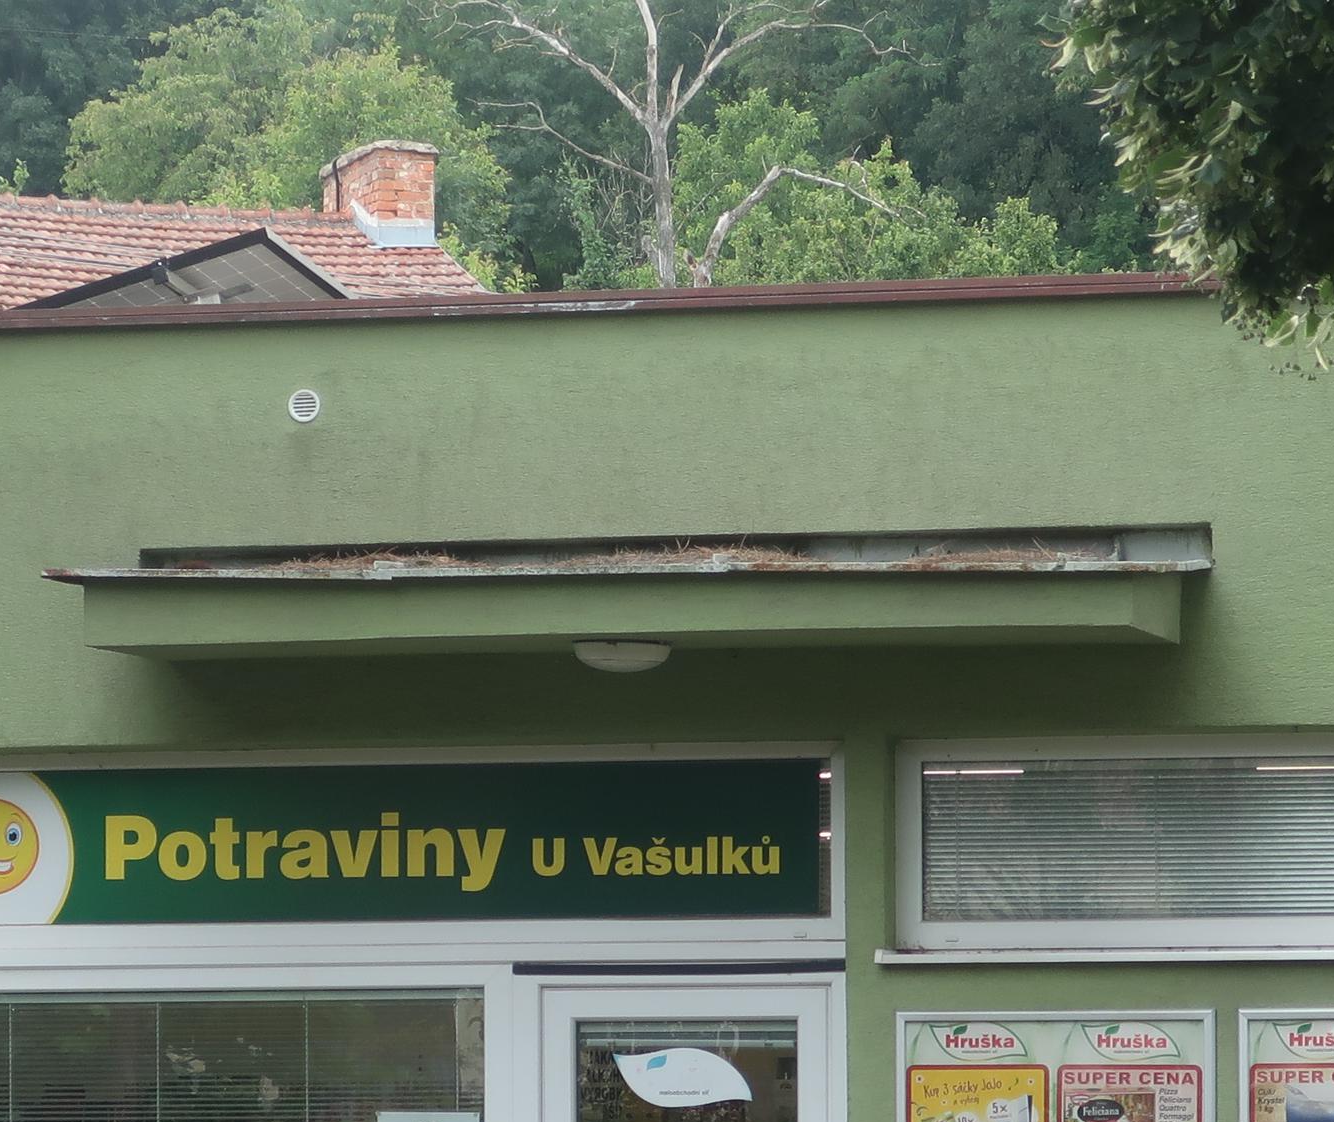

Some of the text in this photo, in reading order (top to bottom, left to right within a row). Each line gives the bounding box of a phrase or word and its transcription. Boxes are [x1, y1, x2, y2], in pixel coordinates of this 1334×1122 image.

[103, 811, 781, 891] Potraviny U Vašulků
[945, 1033, 1015, 1048] Hruška
[1097, 1033, 1167, 1048] Hruška
[1064, 1072, 1194, 1084] SUPER CENA
[1257, 1071, 1324, 1083] SUPER
[923, 1085, 939, 1098] Kup
[1083, 1107, 1119, 1116] Feliciana
